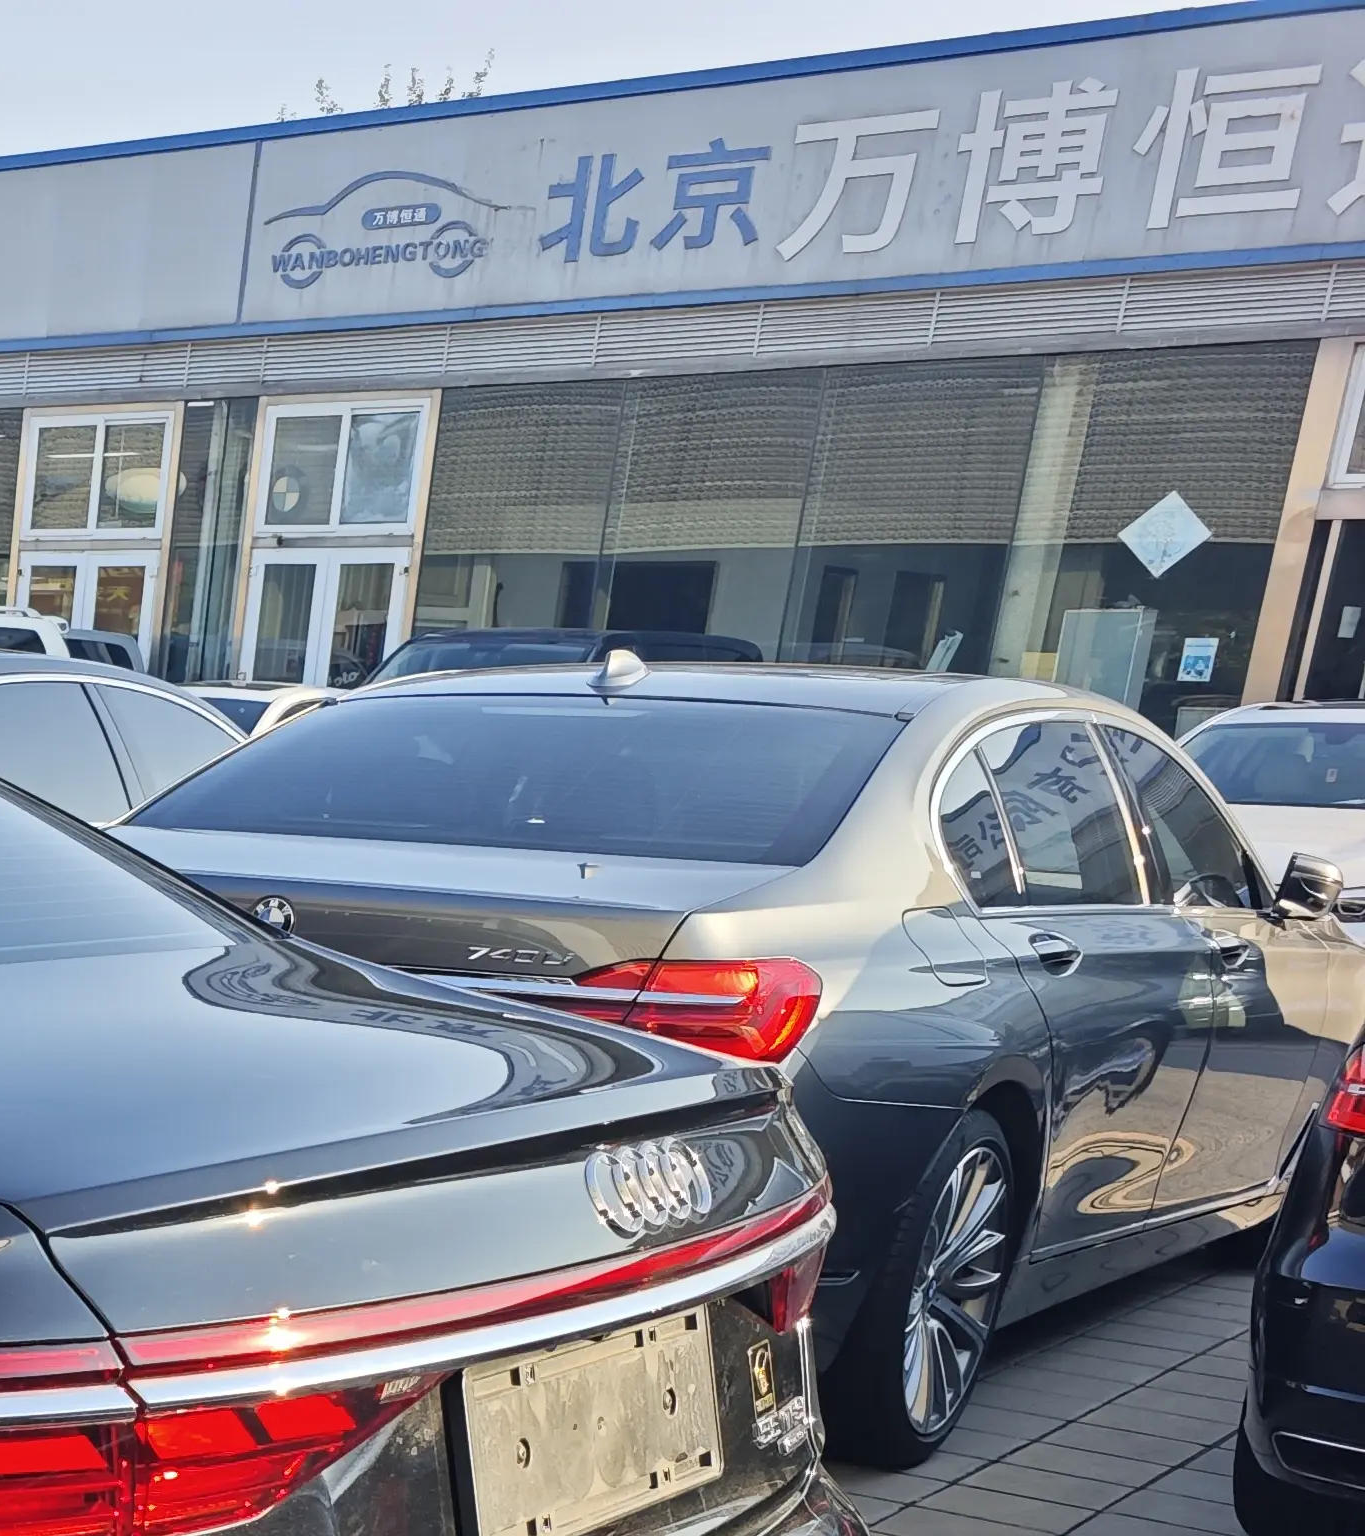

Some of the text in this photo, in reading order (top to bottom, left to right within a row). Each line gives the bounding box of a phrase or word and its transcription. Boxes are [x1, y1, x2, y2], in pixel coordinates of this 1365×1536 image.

[538, 58, 1365, 263] 北京万博恒
[372, 206, 427, 226] 万博恒通
[272, 237, 491, 274] WANBOHENGTONG
